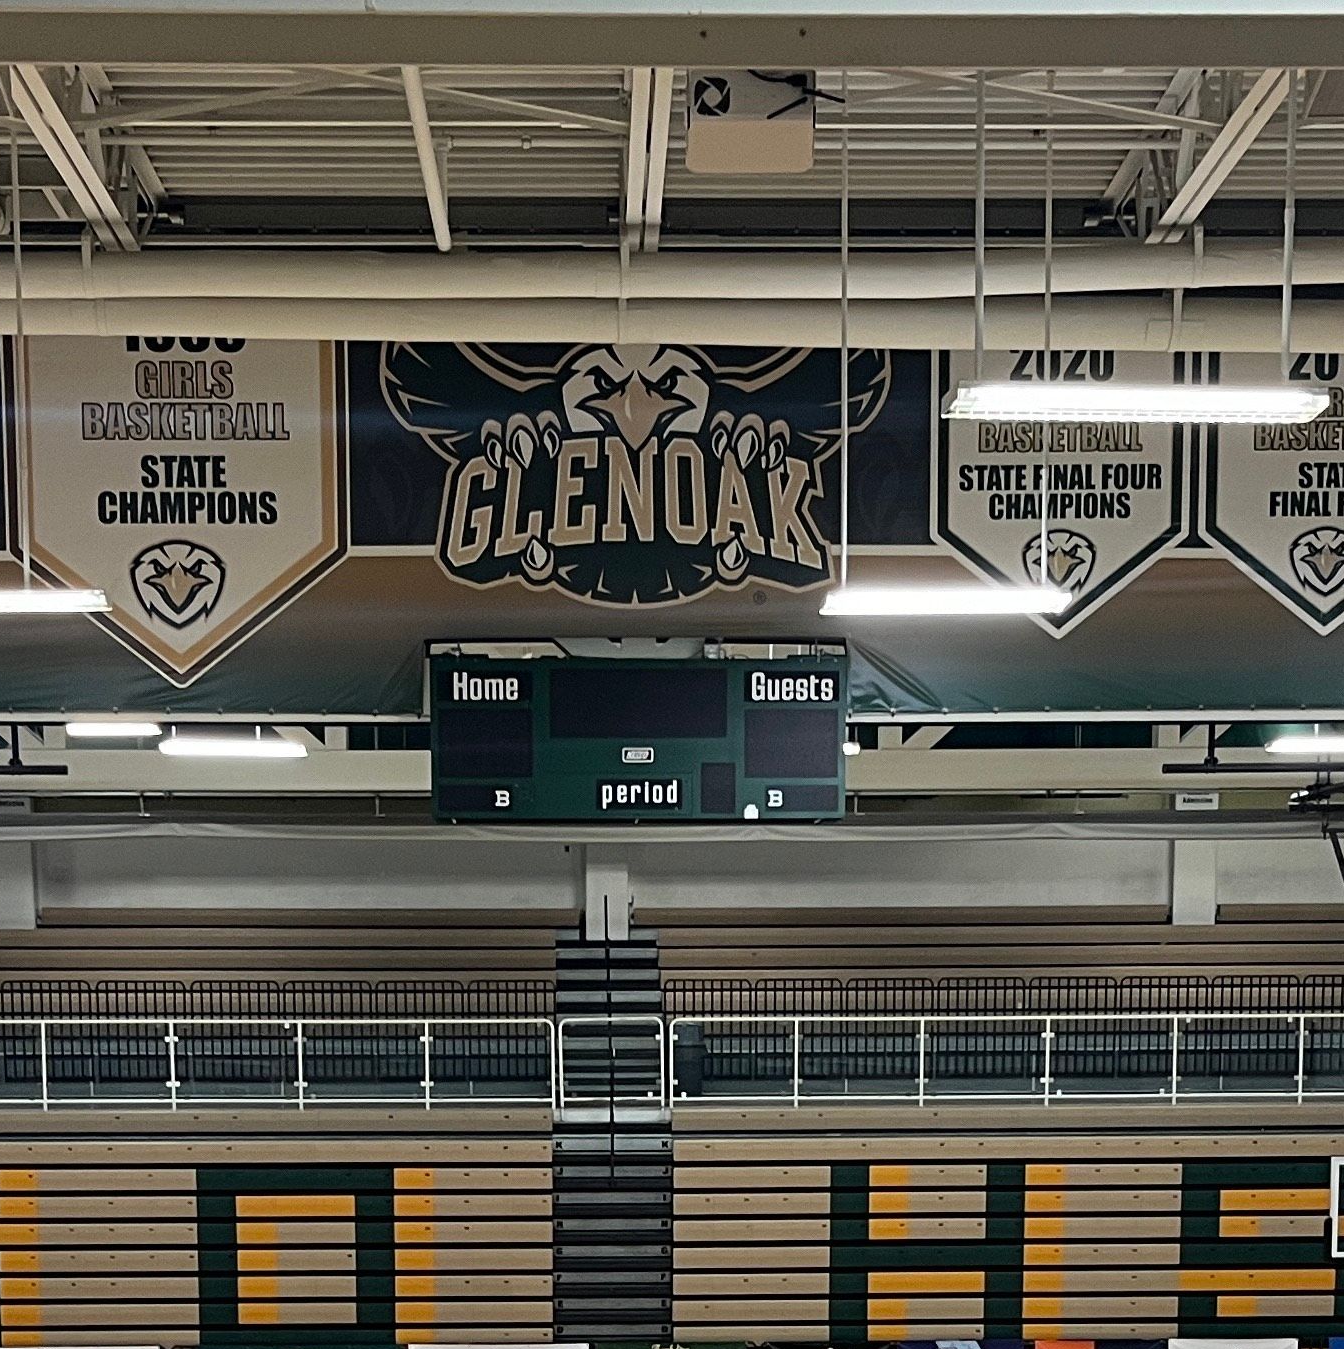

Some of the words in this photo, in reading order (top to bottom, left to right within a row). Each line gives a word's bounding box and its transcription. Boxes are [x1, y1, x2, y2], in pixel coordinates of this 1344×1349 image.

[135, 360, 234, 399] GIRLS
[82, 402, 290, 440] BASKETBALL
[978, 422, 1143, 453] BASKETBALL
[140, 455, 227, 488] STATE
[959, 465, 1027, 491] STATE
[1102, 464, 1162, 490] FOUR
[97, 491, 278, 525] CHAMPIONS
[446, 435, 823, 569] GLENOAK
[988, 493, 1131, 520] CHAMPIONS
[1269, 491, 1332, 517] FINAL
[453, 671, 519, 702] Home
[751, 671, 834, 702] Guests
[495, 790, 511, 808] B
[601, 779, 679, 809] period
[767, 790, 784, 808] B
